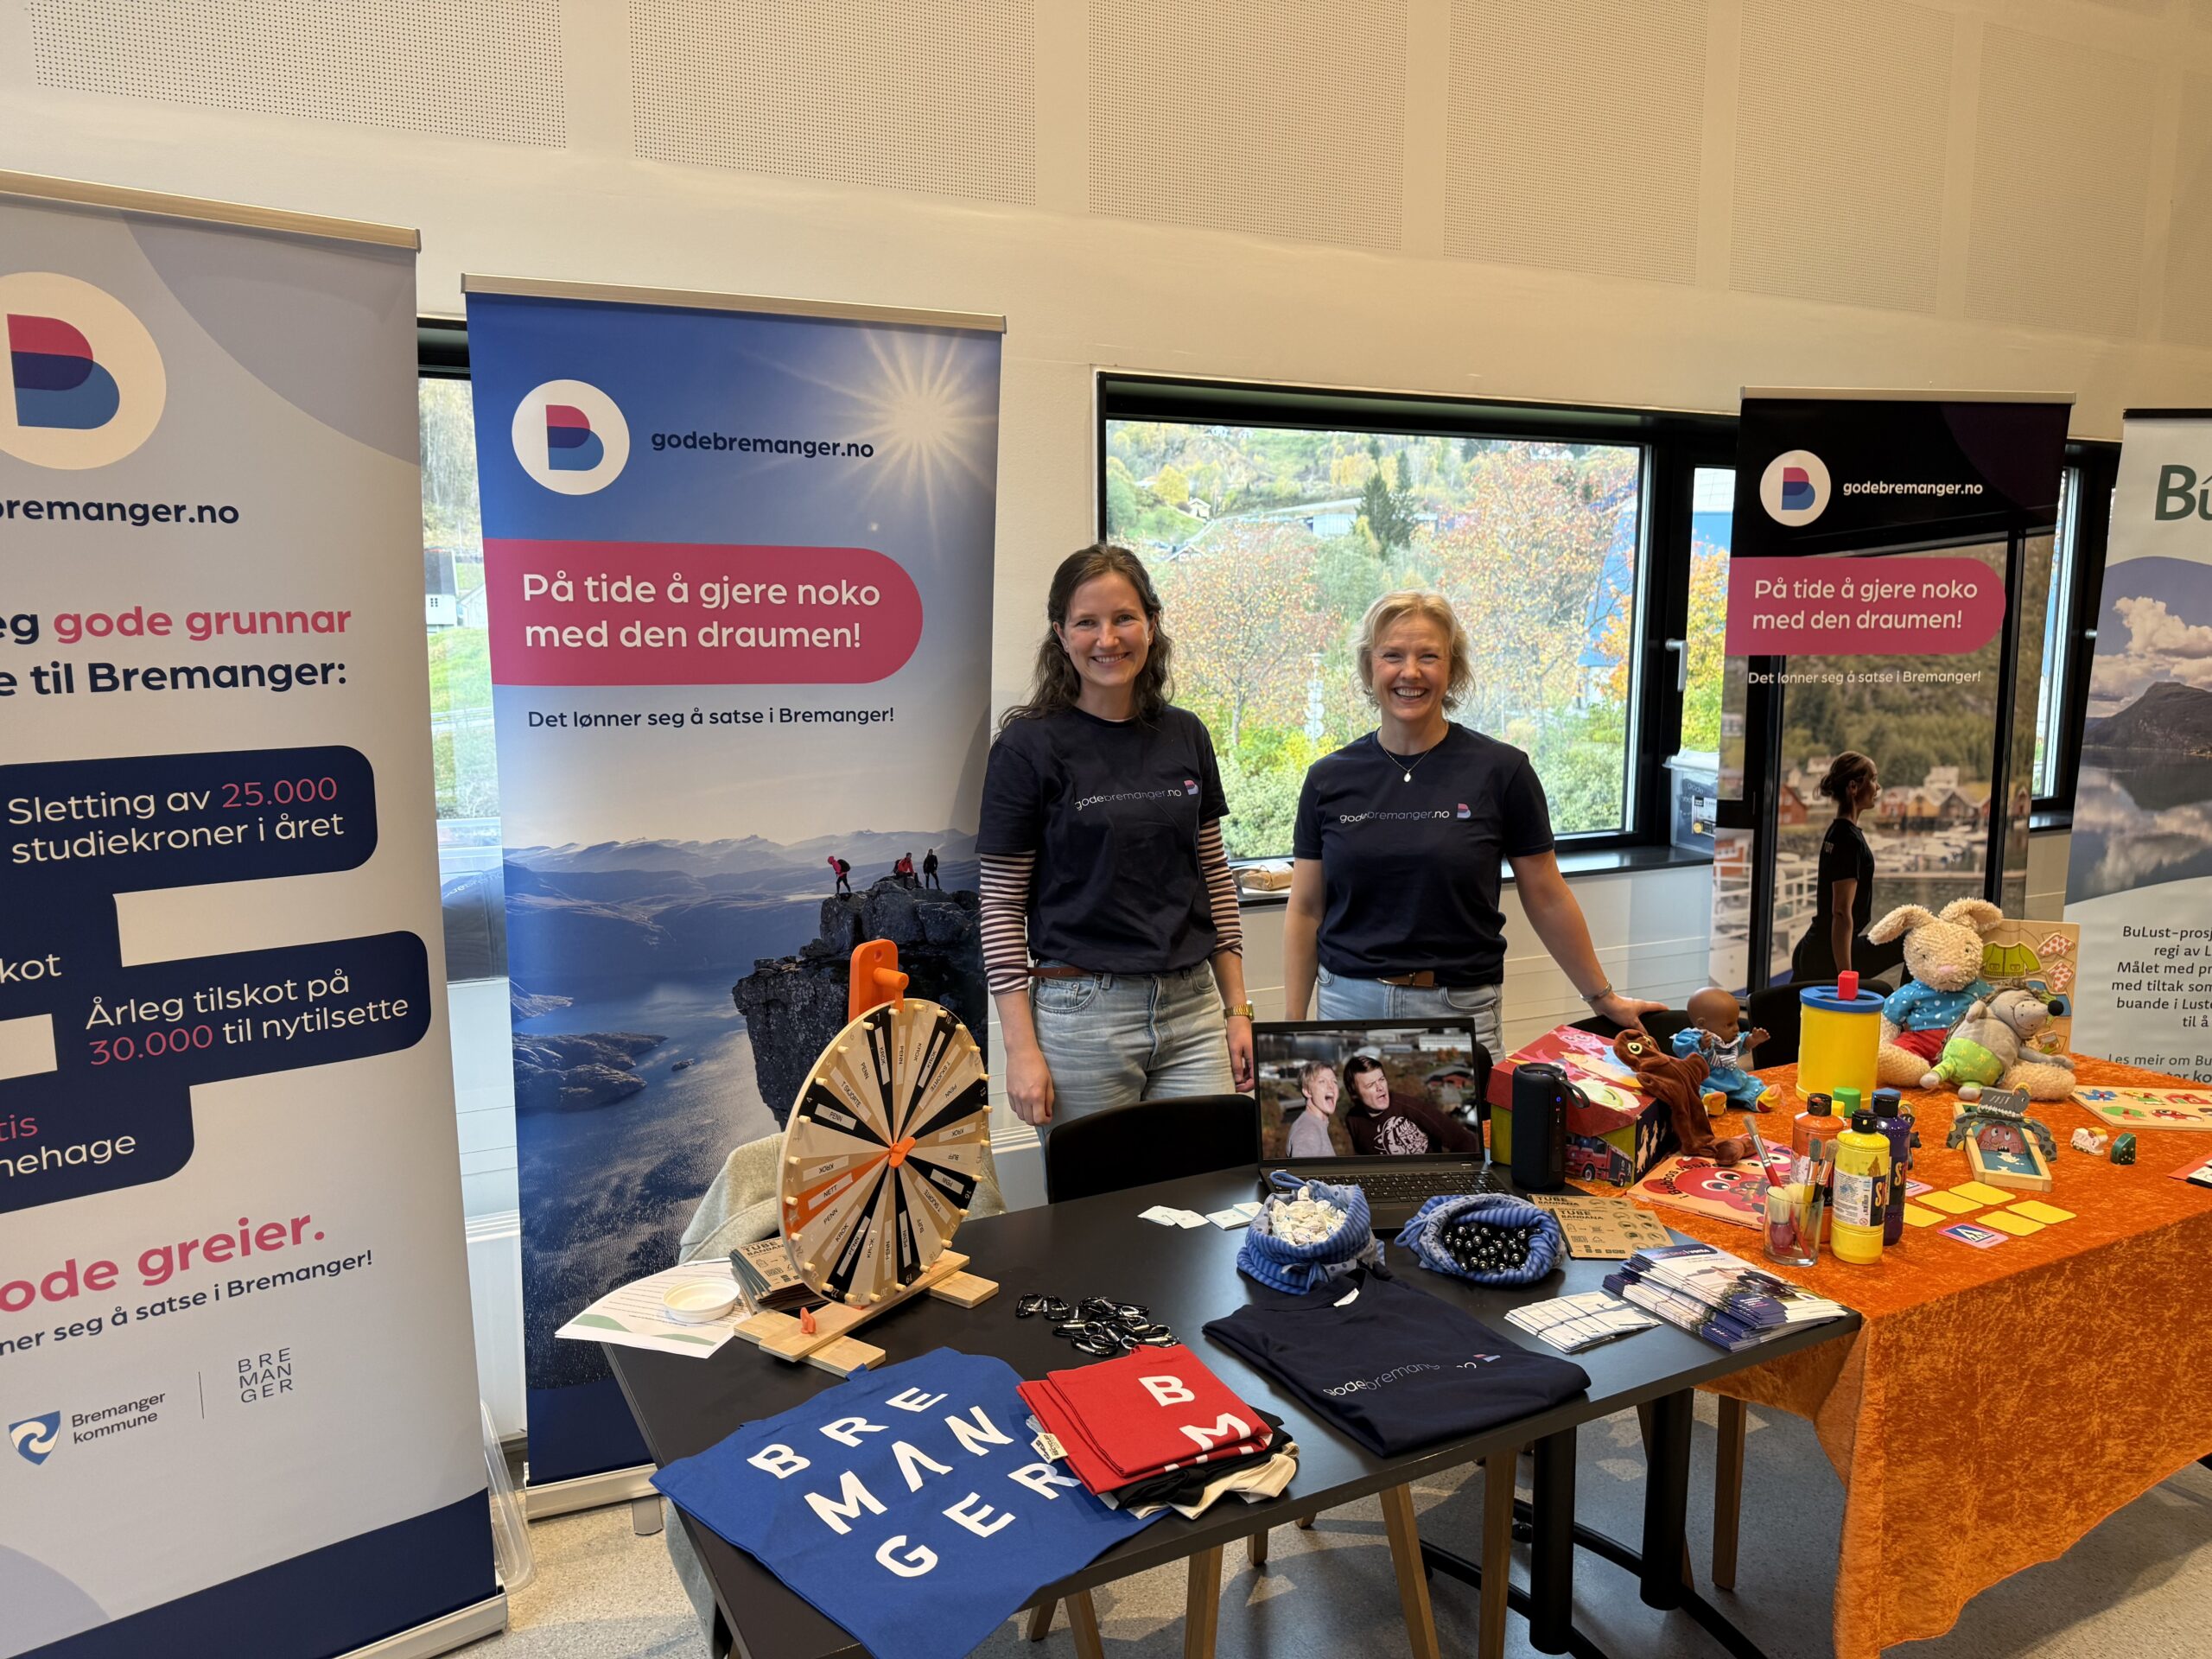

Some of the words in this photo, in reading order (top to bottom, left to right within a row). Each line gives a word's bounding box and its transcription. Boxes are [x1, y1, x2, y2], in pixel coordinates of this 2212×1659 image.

[651, 430, 874, 458] godebremanger.no
[1843, 481, 1984, 497] godebremanger.no
[0, 499, 240, 527] remanger.no
[523, 569, 575, 602] På
[585, 573, 657, 603] tide
[667, 572, 689, 604] å
[700, 576, 788, 610] gjere
[798, 579, 880, 607] noko
[1754, 577, 1787, 599] På
[1794, 579, 1835, 599] tide
[1841, 577, 1854, 599] å
[1860, 579, 1916, 603] gjere
[1922, 580, 1978, 600] noko
[54, 606, 173, 645] gode
[185, 609, 352, 641] grunnar
[1752, 610, 1805, 630] med
[1810, 610, 1851, 630] den
[1856, 610, 1962, 630] draumen!
[525, 620, 609, 648] med
[620, 620, 688, 648] den
[697, 621, 861, 649] draumen!
[29, 660, 75, 696] til
[88, 661, 347, 694] Bremanger:
[1748, 671, 1774, 684] Det
[1777, 671, 1819, 684] lønner
[1821, 672, 1844, 686] seg
[1847, 671, 1856, 683] å
[1858, 671, 1893, 683] satse
[1903, 670, 1981, 685] Bremanger!
[528, 710, 568, 728] Det
[574, 710, 642, 728] lønner
[647, 711, 685, 728] seg
[691, 707, 704, 725] å
[709, 709, 765, 725] satse
[769, 707, 774, 723] i
[779, 706, 894, 726] Bremanger!
[8, 789, 156, 825] Sletting
[166, 789, 211, 811] av
[220, 777, 338, 809] 25.000
[1074, 789, 1182, 811] godebremanger.no
[12, 820, 249, 865] studiekroner
[257, 817, 266, 842] i
[275, 812, 345, 841] året
[2154, 944, 2180, 959] regi
[2183, 947, 2201, 957] av
[2117, 960, 2160, 975] Målet
[2164, 963, 2195, 975] med
[2111, 980, 2142, 992] med
[2146, 979, 2184, 993] tiltak
[86, 995, 184, 1030] Årleg
[194, 977, 298, 1016] tilskot
[308, 968, 349, 1002] på
[2116, 996, 2170, 1010] buande
[2173, 998, 2178, 1010] i
[89, 1024, 213, 1065] 30.000
[222, 1019, 253, 1045] til
[262, 996, 409, 1043] nytilsette
[2183, 1015, 2196, 1028] til
[2200, 1014, 2209, 1028] å
[2134, 1053, 2165, 1065] meir
[2169, 1057, 2190, 1066] om
[861, 1062, 870, 1080] PENN
[944, 1084, 957, 1099] PENN
[818, 1162, 835, 1174] KROK
[823, 1185, 838, 1198] NETT
[823, 1208, 838, 1225] PENN
[835, 1223, 849, 1243] KROK
[137, 1213, 326, 1287] greier.
[743, 1241, 779, 1252] TUBE
[747, 1244, 785, 1256] BANDAN
[848, 1236, 860, 1256] PENN
[867, 1237, 875, 1259] KROK
[54, 1317, 103, 1342] seg
[111, 1306, 128, 1326] å
[136, 1290, 207, 1320] satse
[213, 1283, 221, 1301] i
[227, 1249, 373, 1299] Bremanger!
[238, 1347, 291, 1374] BRE
[238, 1363, 292, 1389] MAN
[240, 1378, 294, 1404] GER
[1137, 1375, 1196, 1407] B
[72, 1392, 166, 1428] Bremanger
[73, 1411, 158, 1445] kommune
[1179, 1412, 1252, 1452] M
